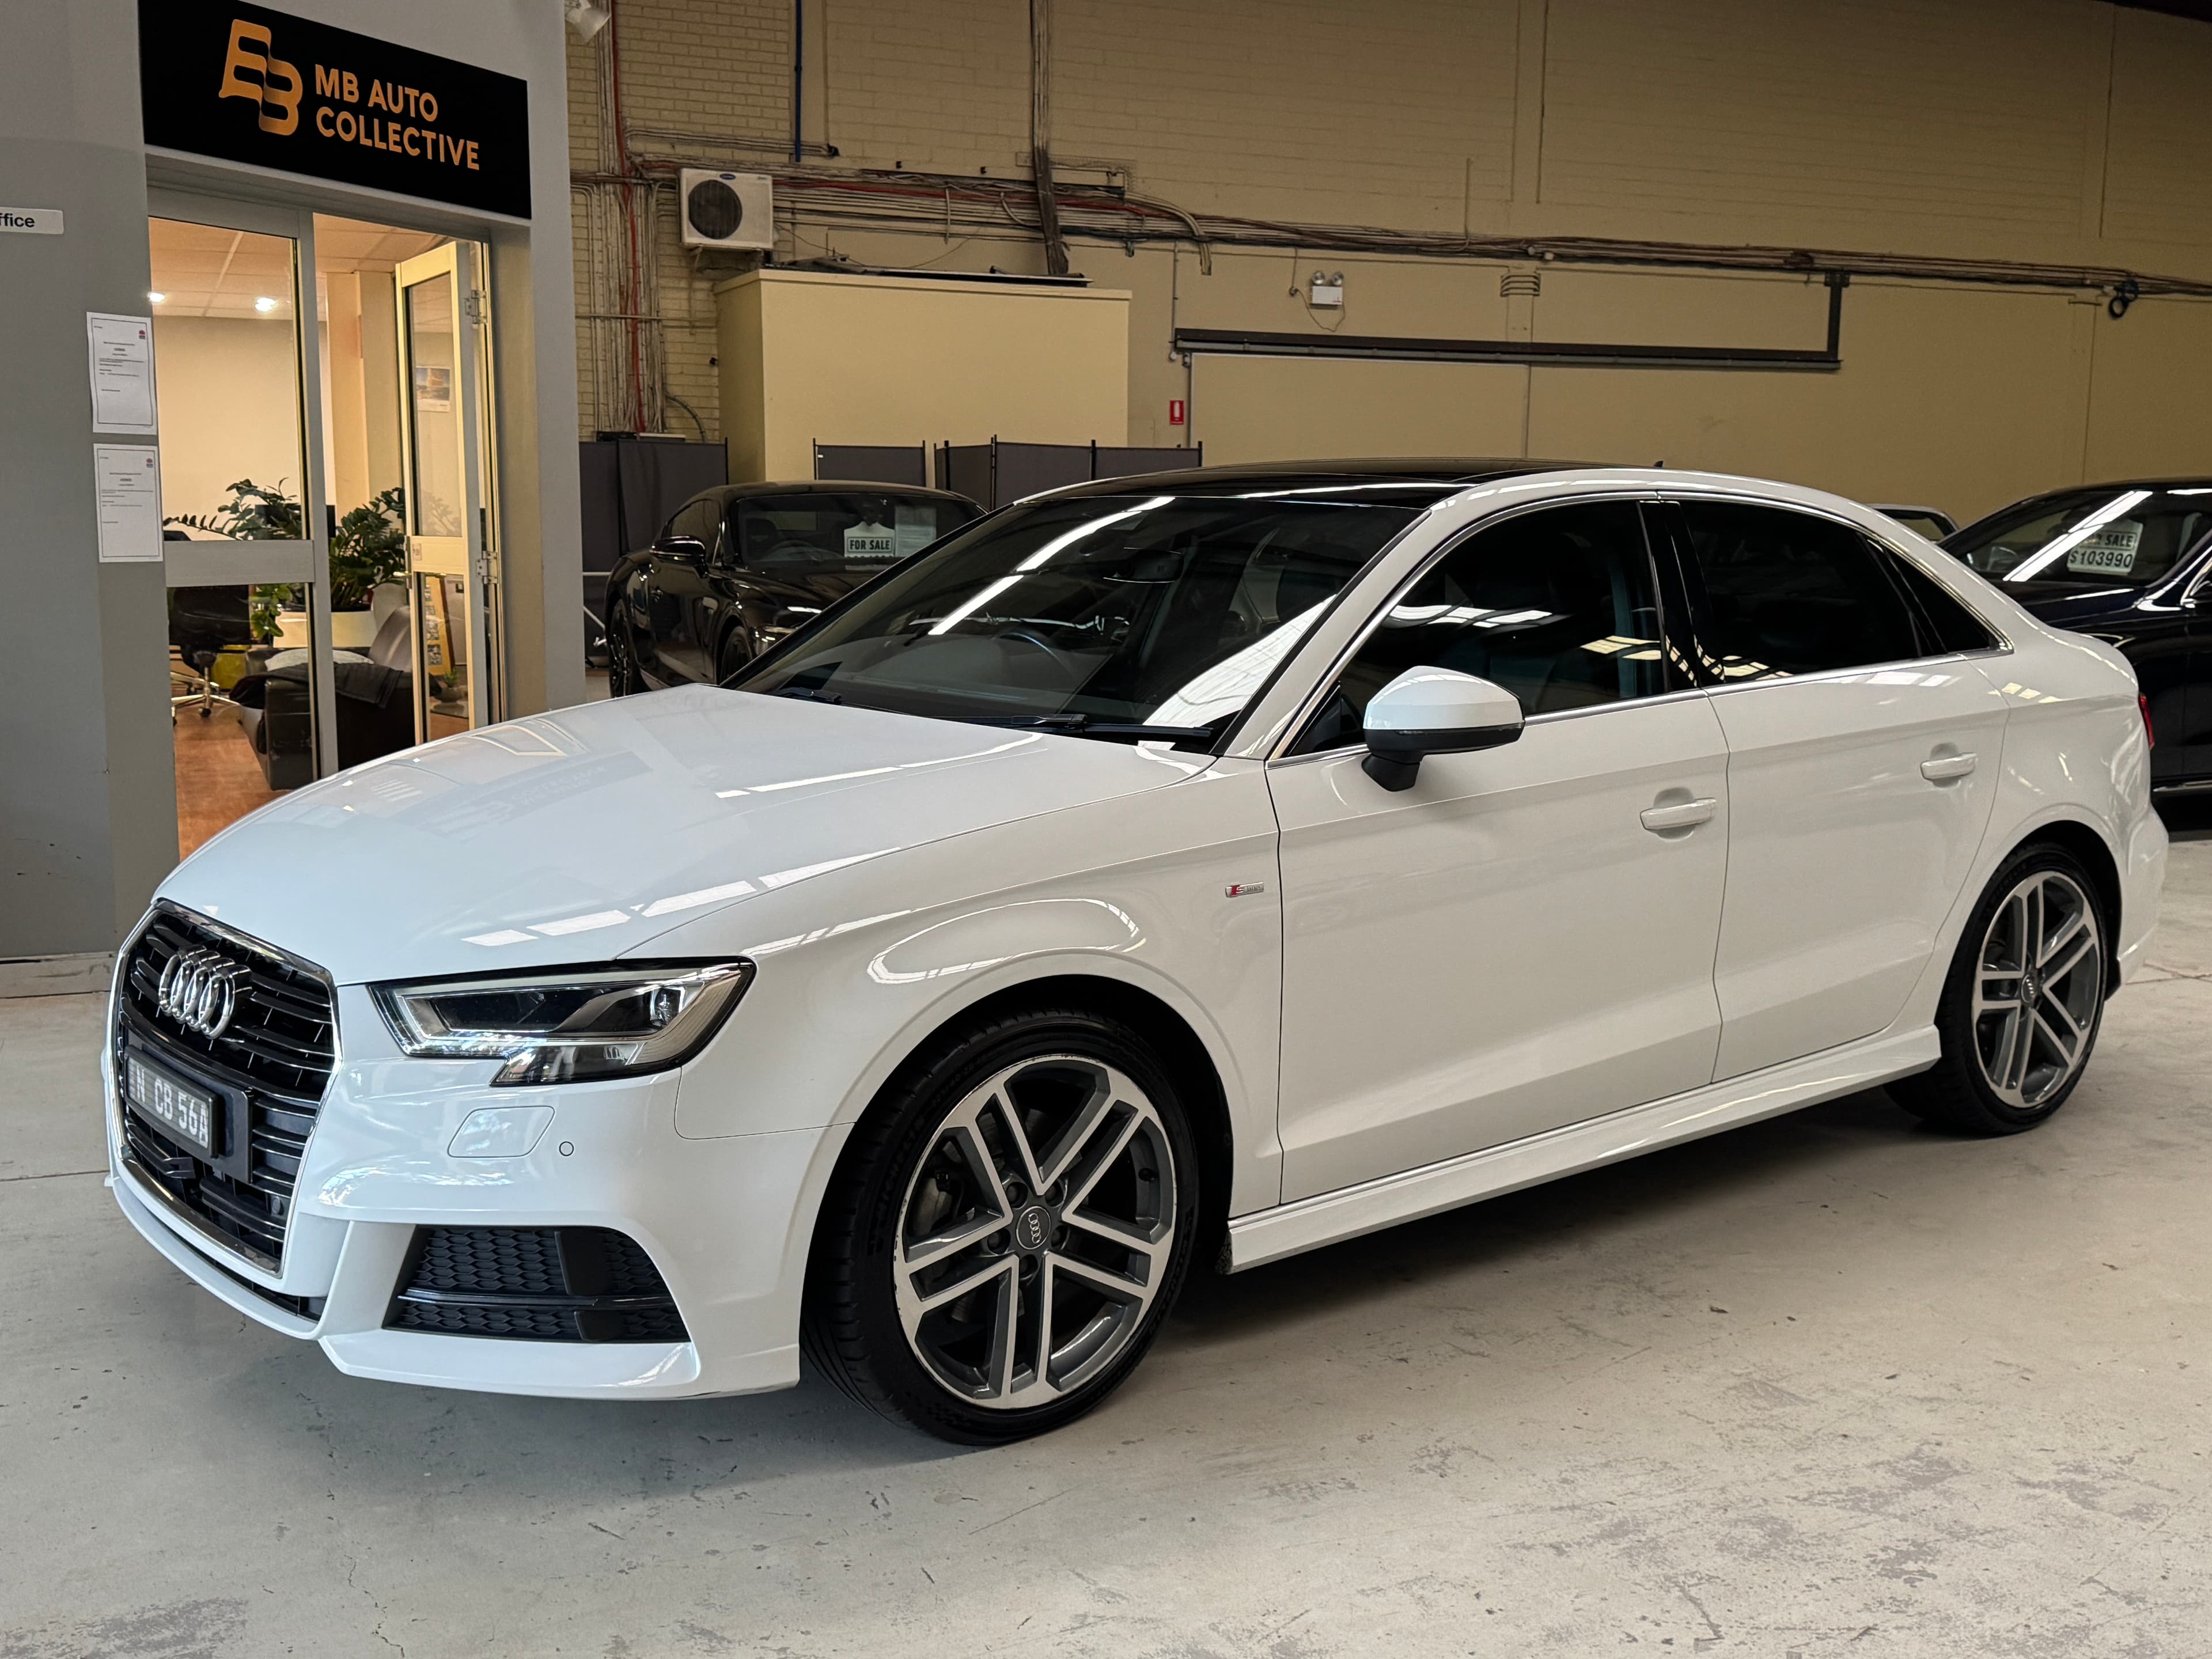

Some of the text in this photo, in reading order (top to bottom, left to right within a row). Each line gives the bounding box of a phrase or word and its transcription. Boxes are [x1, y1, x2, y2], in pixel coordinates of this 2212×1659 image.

[315, 64, 438, 122] MB AUTO
[316, 107, 480, 171] COLLECTIVE
[850, 540, 890, 550] FOR SALE
[2105, 534, 2133, 547] SALE
